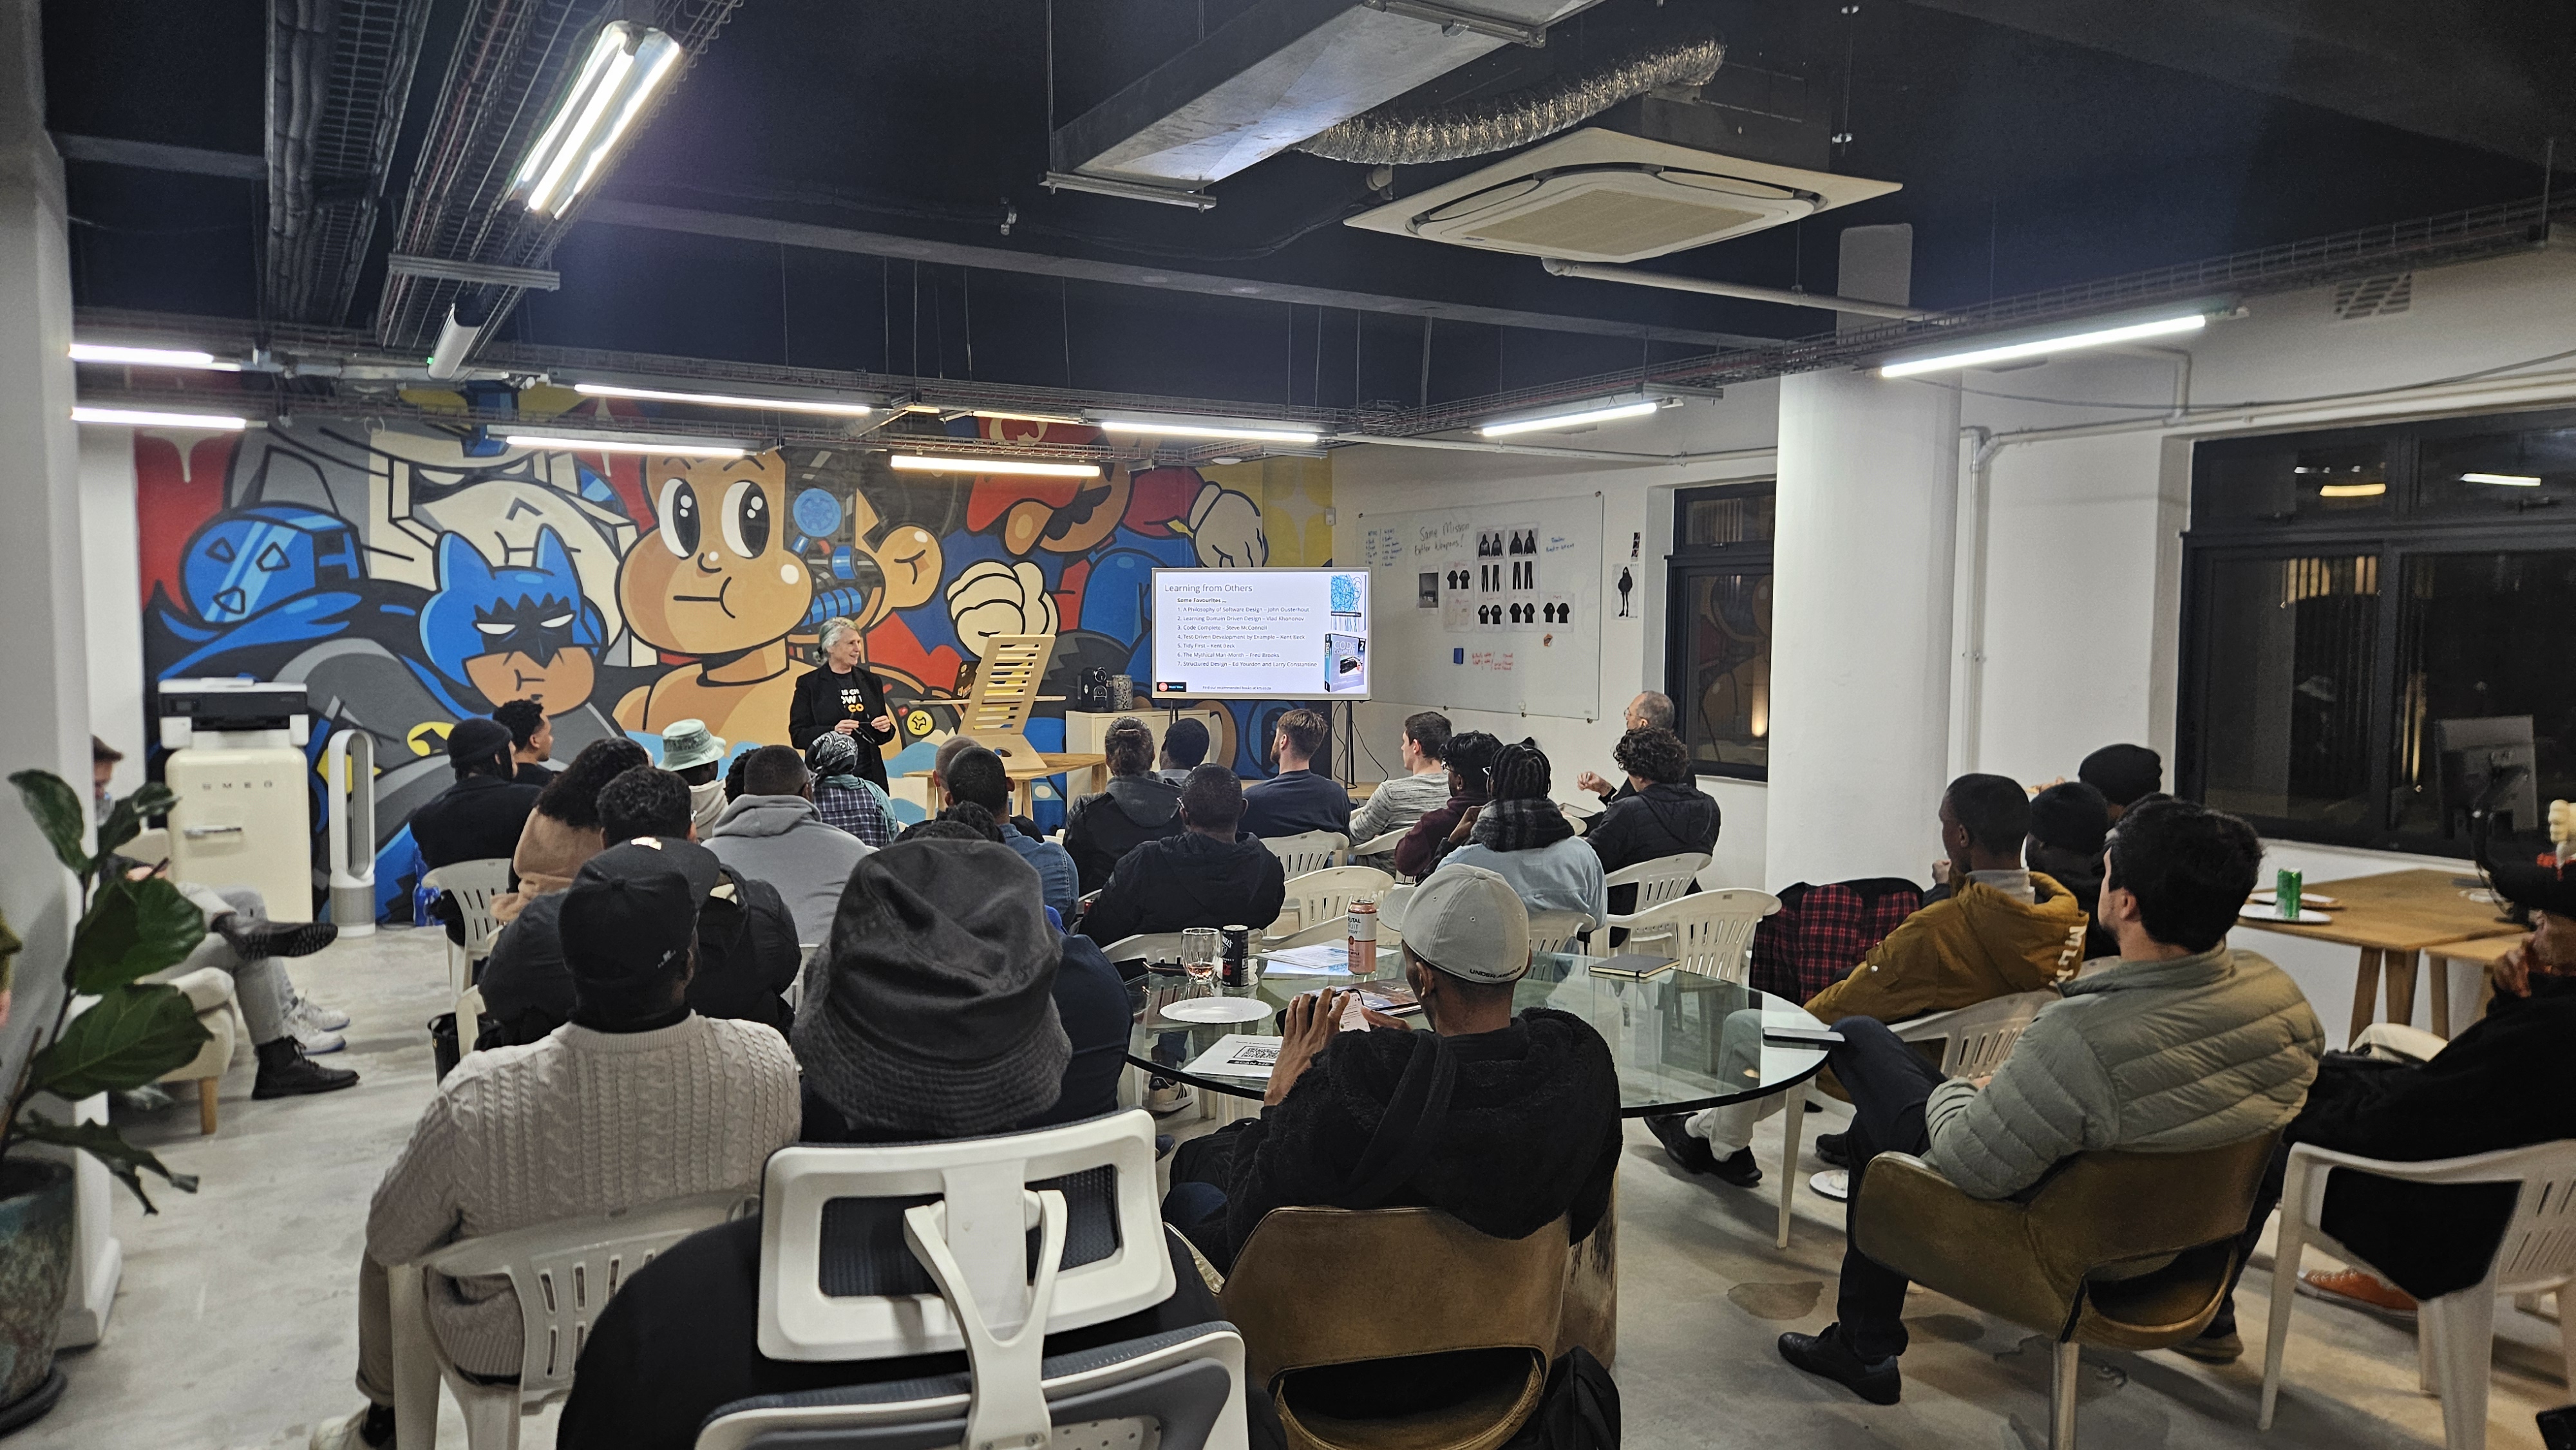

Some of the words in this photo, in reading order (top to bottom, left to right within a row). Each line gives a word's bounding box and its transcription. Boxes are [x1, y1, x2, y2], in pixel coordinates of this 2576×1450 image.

[1165, 584, 1200, 593] Learning
[1334, 640, 1356, 650] CODE
[1359, 642, 1365, 651] 2
[202, 780, 272, 790] SMEG
[1470, 968, 1496, 979] UNDER
